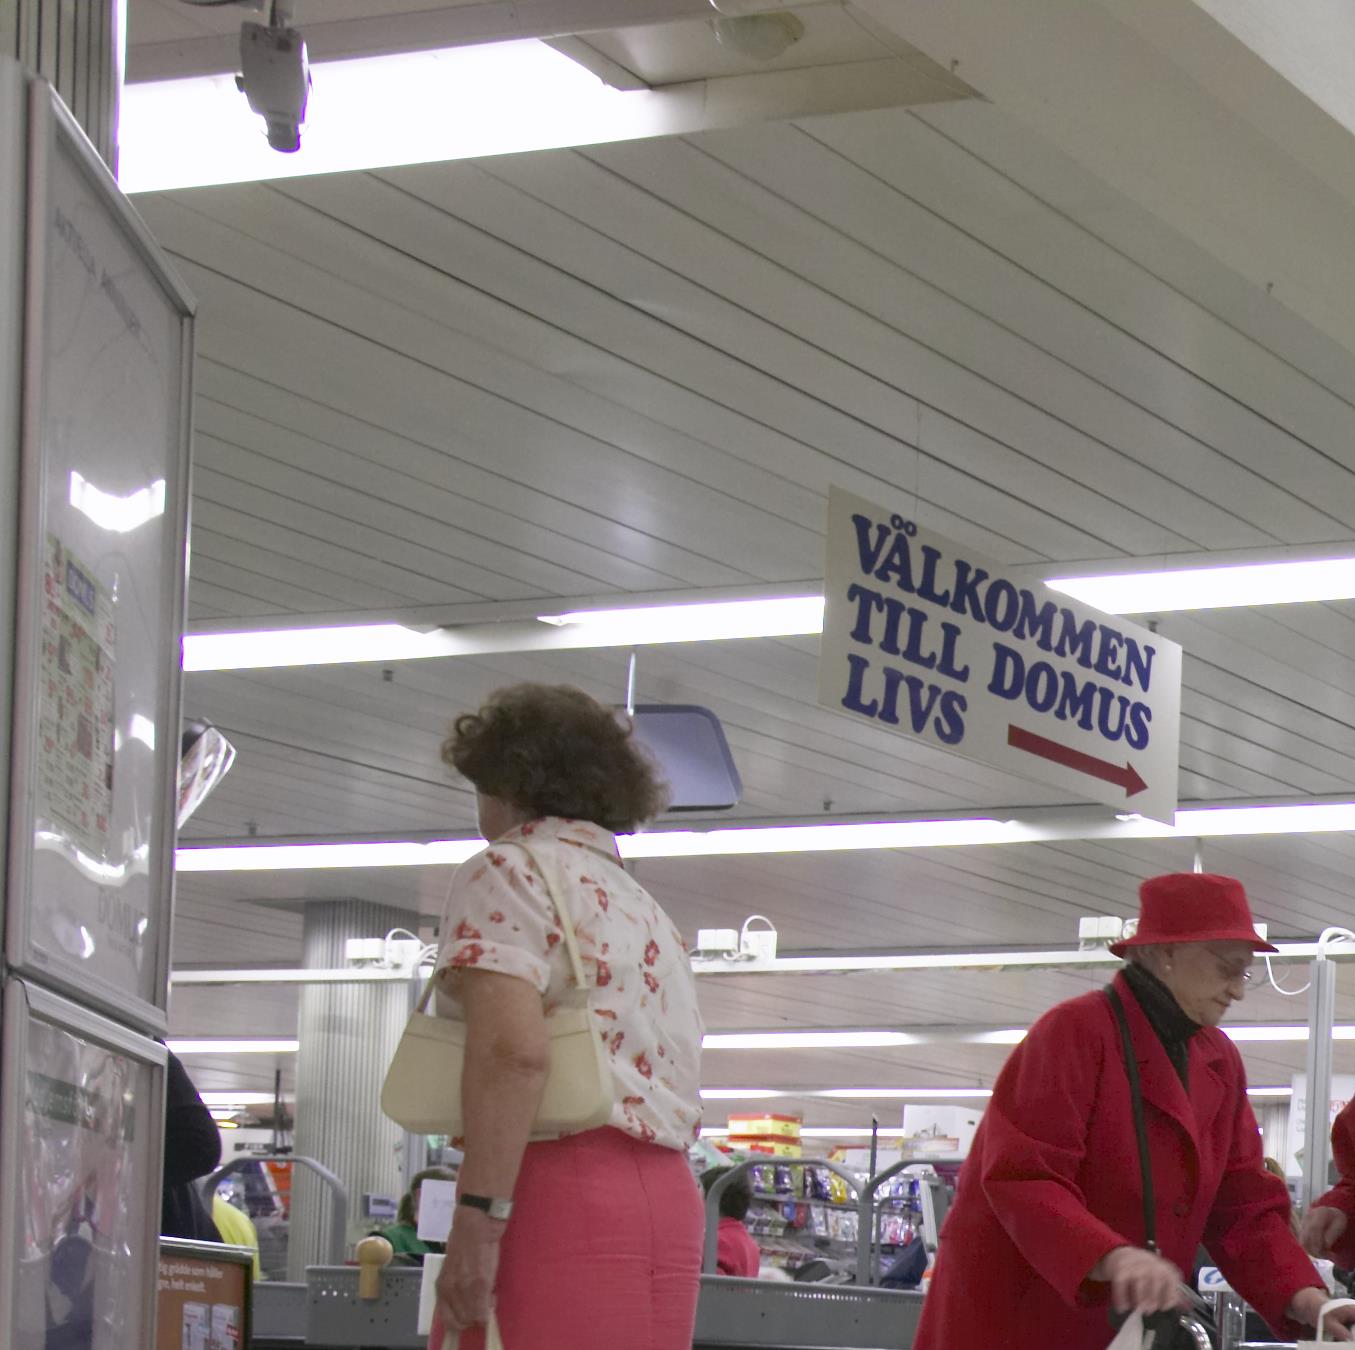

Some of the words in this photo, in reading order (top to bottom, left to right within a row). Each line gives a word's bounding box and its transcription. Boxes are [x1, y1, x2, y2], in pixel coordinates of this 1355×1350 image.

[847, 583, 970, 683] TILL
[987, 642, 1152, 751] DOMUS
[851, 514, 1156, 693] VÄLKOMMEN
[841, 653, 968, 745] LIVS
